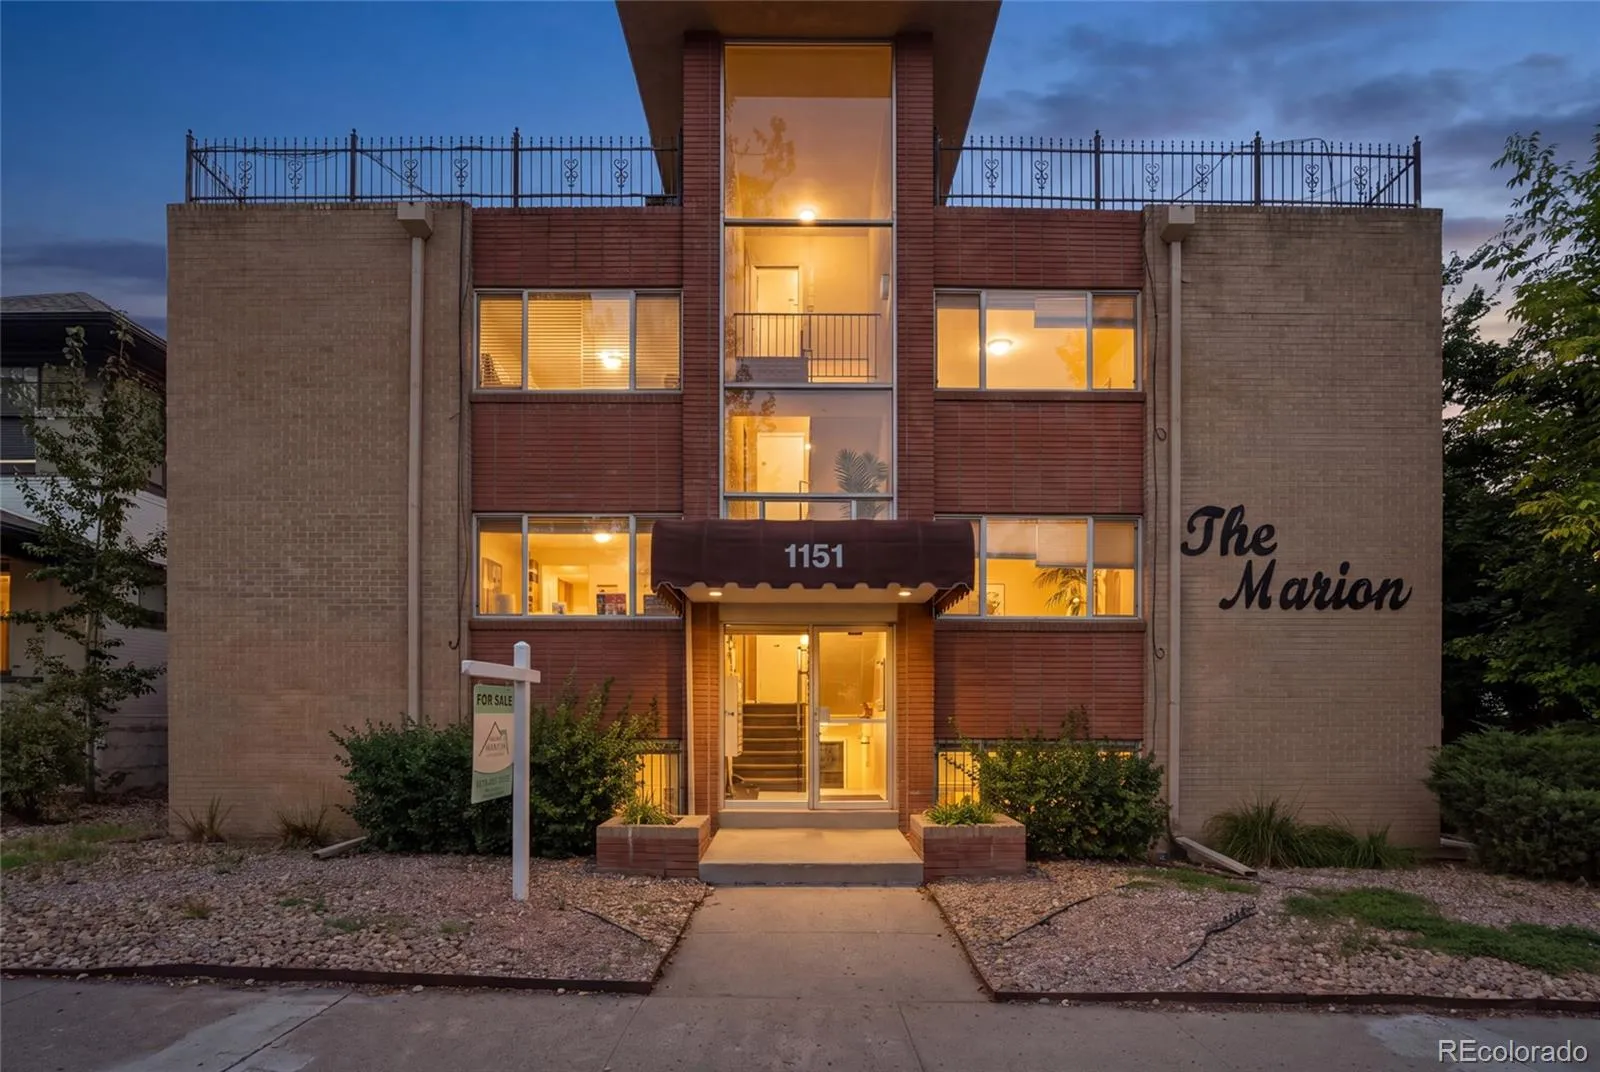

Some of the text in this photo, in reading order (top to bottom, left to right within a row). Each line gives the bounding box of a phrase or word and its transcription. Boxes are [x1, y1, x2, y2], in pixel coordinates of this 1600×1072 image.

[1180, 504, 1277, 556] The
[784, 543, 843, 568] 1151
[1218, 559, 1413, 611] Marion
[476, 693, 513, 706] FOR SALE
